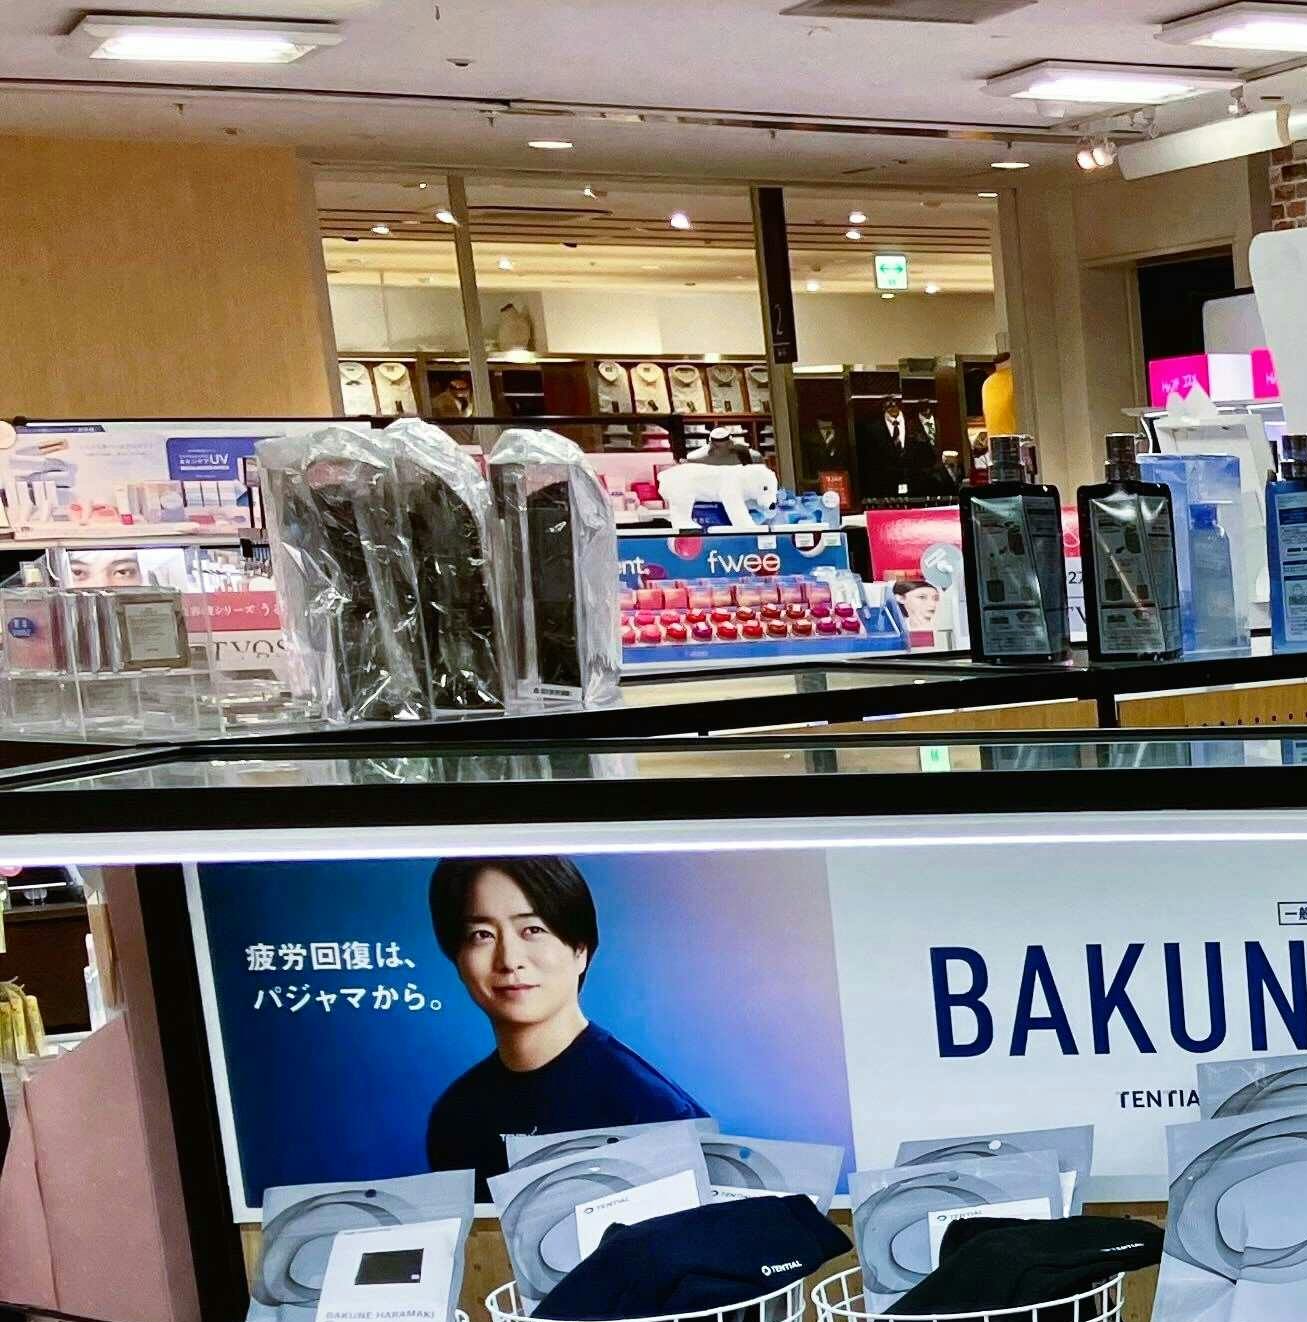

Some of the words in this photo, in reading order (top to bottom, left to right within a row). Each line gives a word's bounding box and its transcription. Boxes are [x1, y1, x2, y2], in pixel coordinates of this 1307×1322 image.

[209, 453, 229, 465] UV
[707, 550, 780, 574] fwee
[245, 941, 417, 973] 疲労回復は、
[253, 984, 444, 1014] パジャマから。
[1117, 1088, 1200, 1110] TENTIA
[771, 1260, 803, 1274] TENTIAL
[326, 1311, 375, 1320] BAKUNE
[376, 1309, 436, 1320] HARAMAKI
